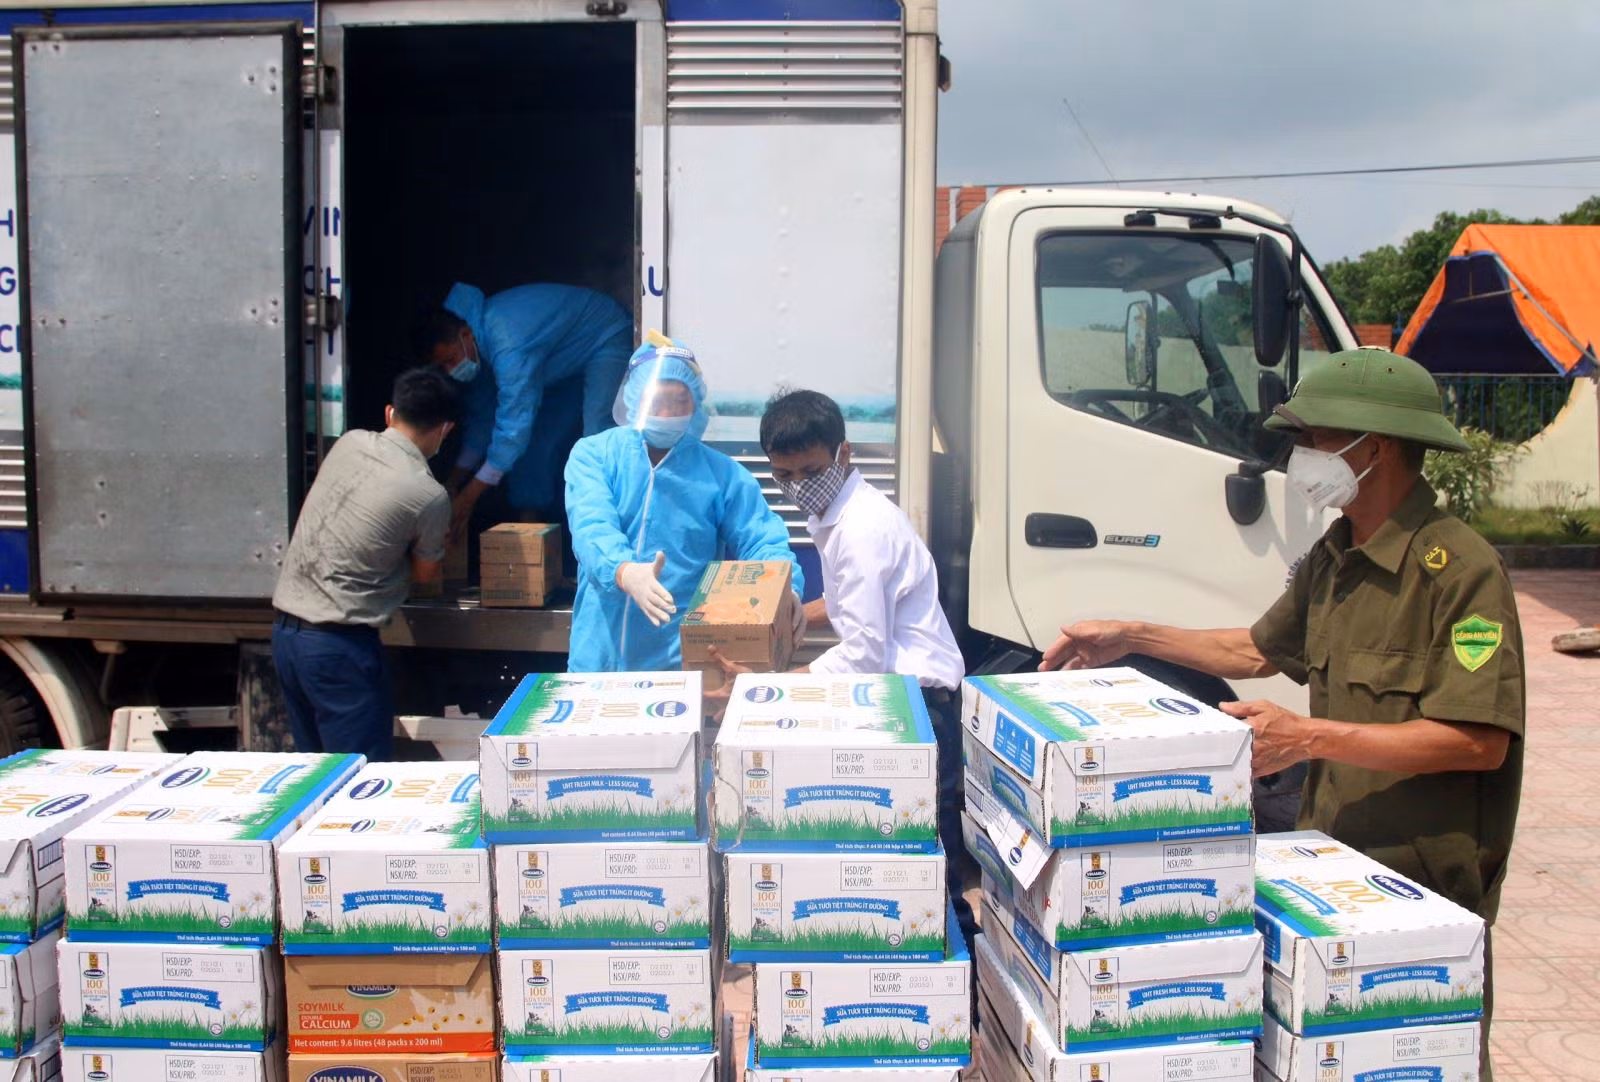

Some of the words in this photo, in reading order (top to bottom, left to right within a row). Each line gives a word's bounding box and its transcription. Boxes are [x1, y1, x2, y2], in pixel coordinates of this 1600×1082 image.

[298, 1003, 345, 1012] SOYMILK
[301, 1020, 351, 1029] CALCIUM
[294, 1039, 308, 1047] Net
[309, 1039, 339, 1047] content:
[340, 1038, 353, 1047] 9.6
[353, 1038, 373, 1047] litres
[373, 1038, 386, 1048] (48
[387, 1038, 408, 1049] packs
[415, 1038, 429, 1047] 200
[430, 1037, 443, 1047] ml)
